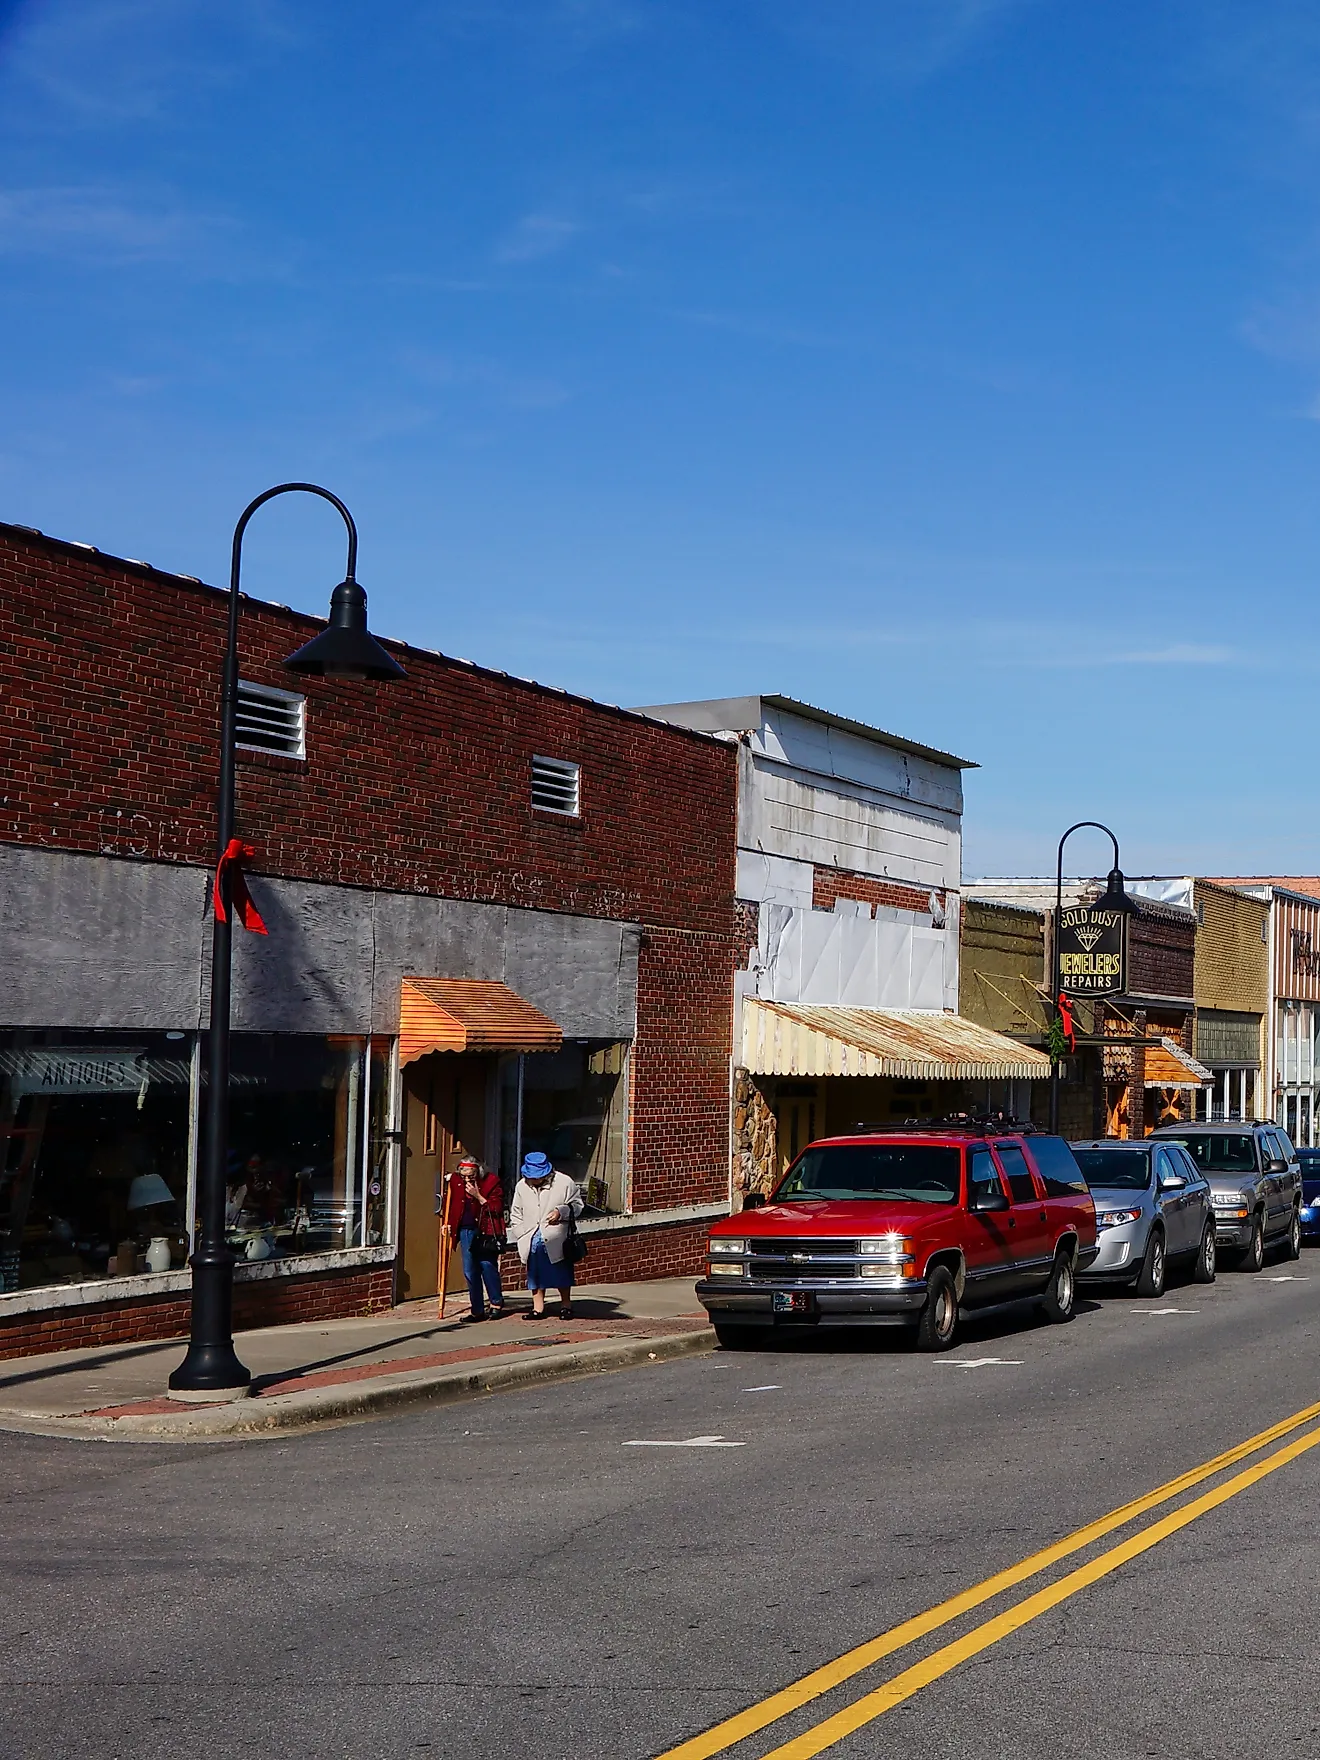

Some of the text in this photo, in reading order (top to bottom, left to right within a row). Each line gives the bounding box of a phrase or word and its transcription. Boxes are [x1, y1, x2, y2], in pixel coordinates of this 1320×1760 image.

[1061, 908, 1120, 929] GOLD DUST
[1060, 953, 1120, 975] JEWELERS
[1063, 975, 1112, 987] REPAIRS
[41, 1061, 125, 1085] ANTIQUES
